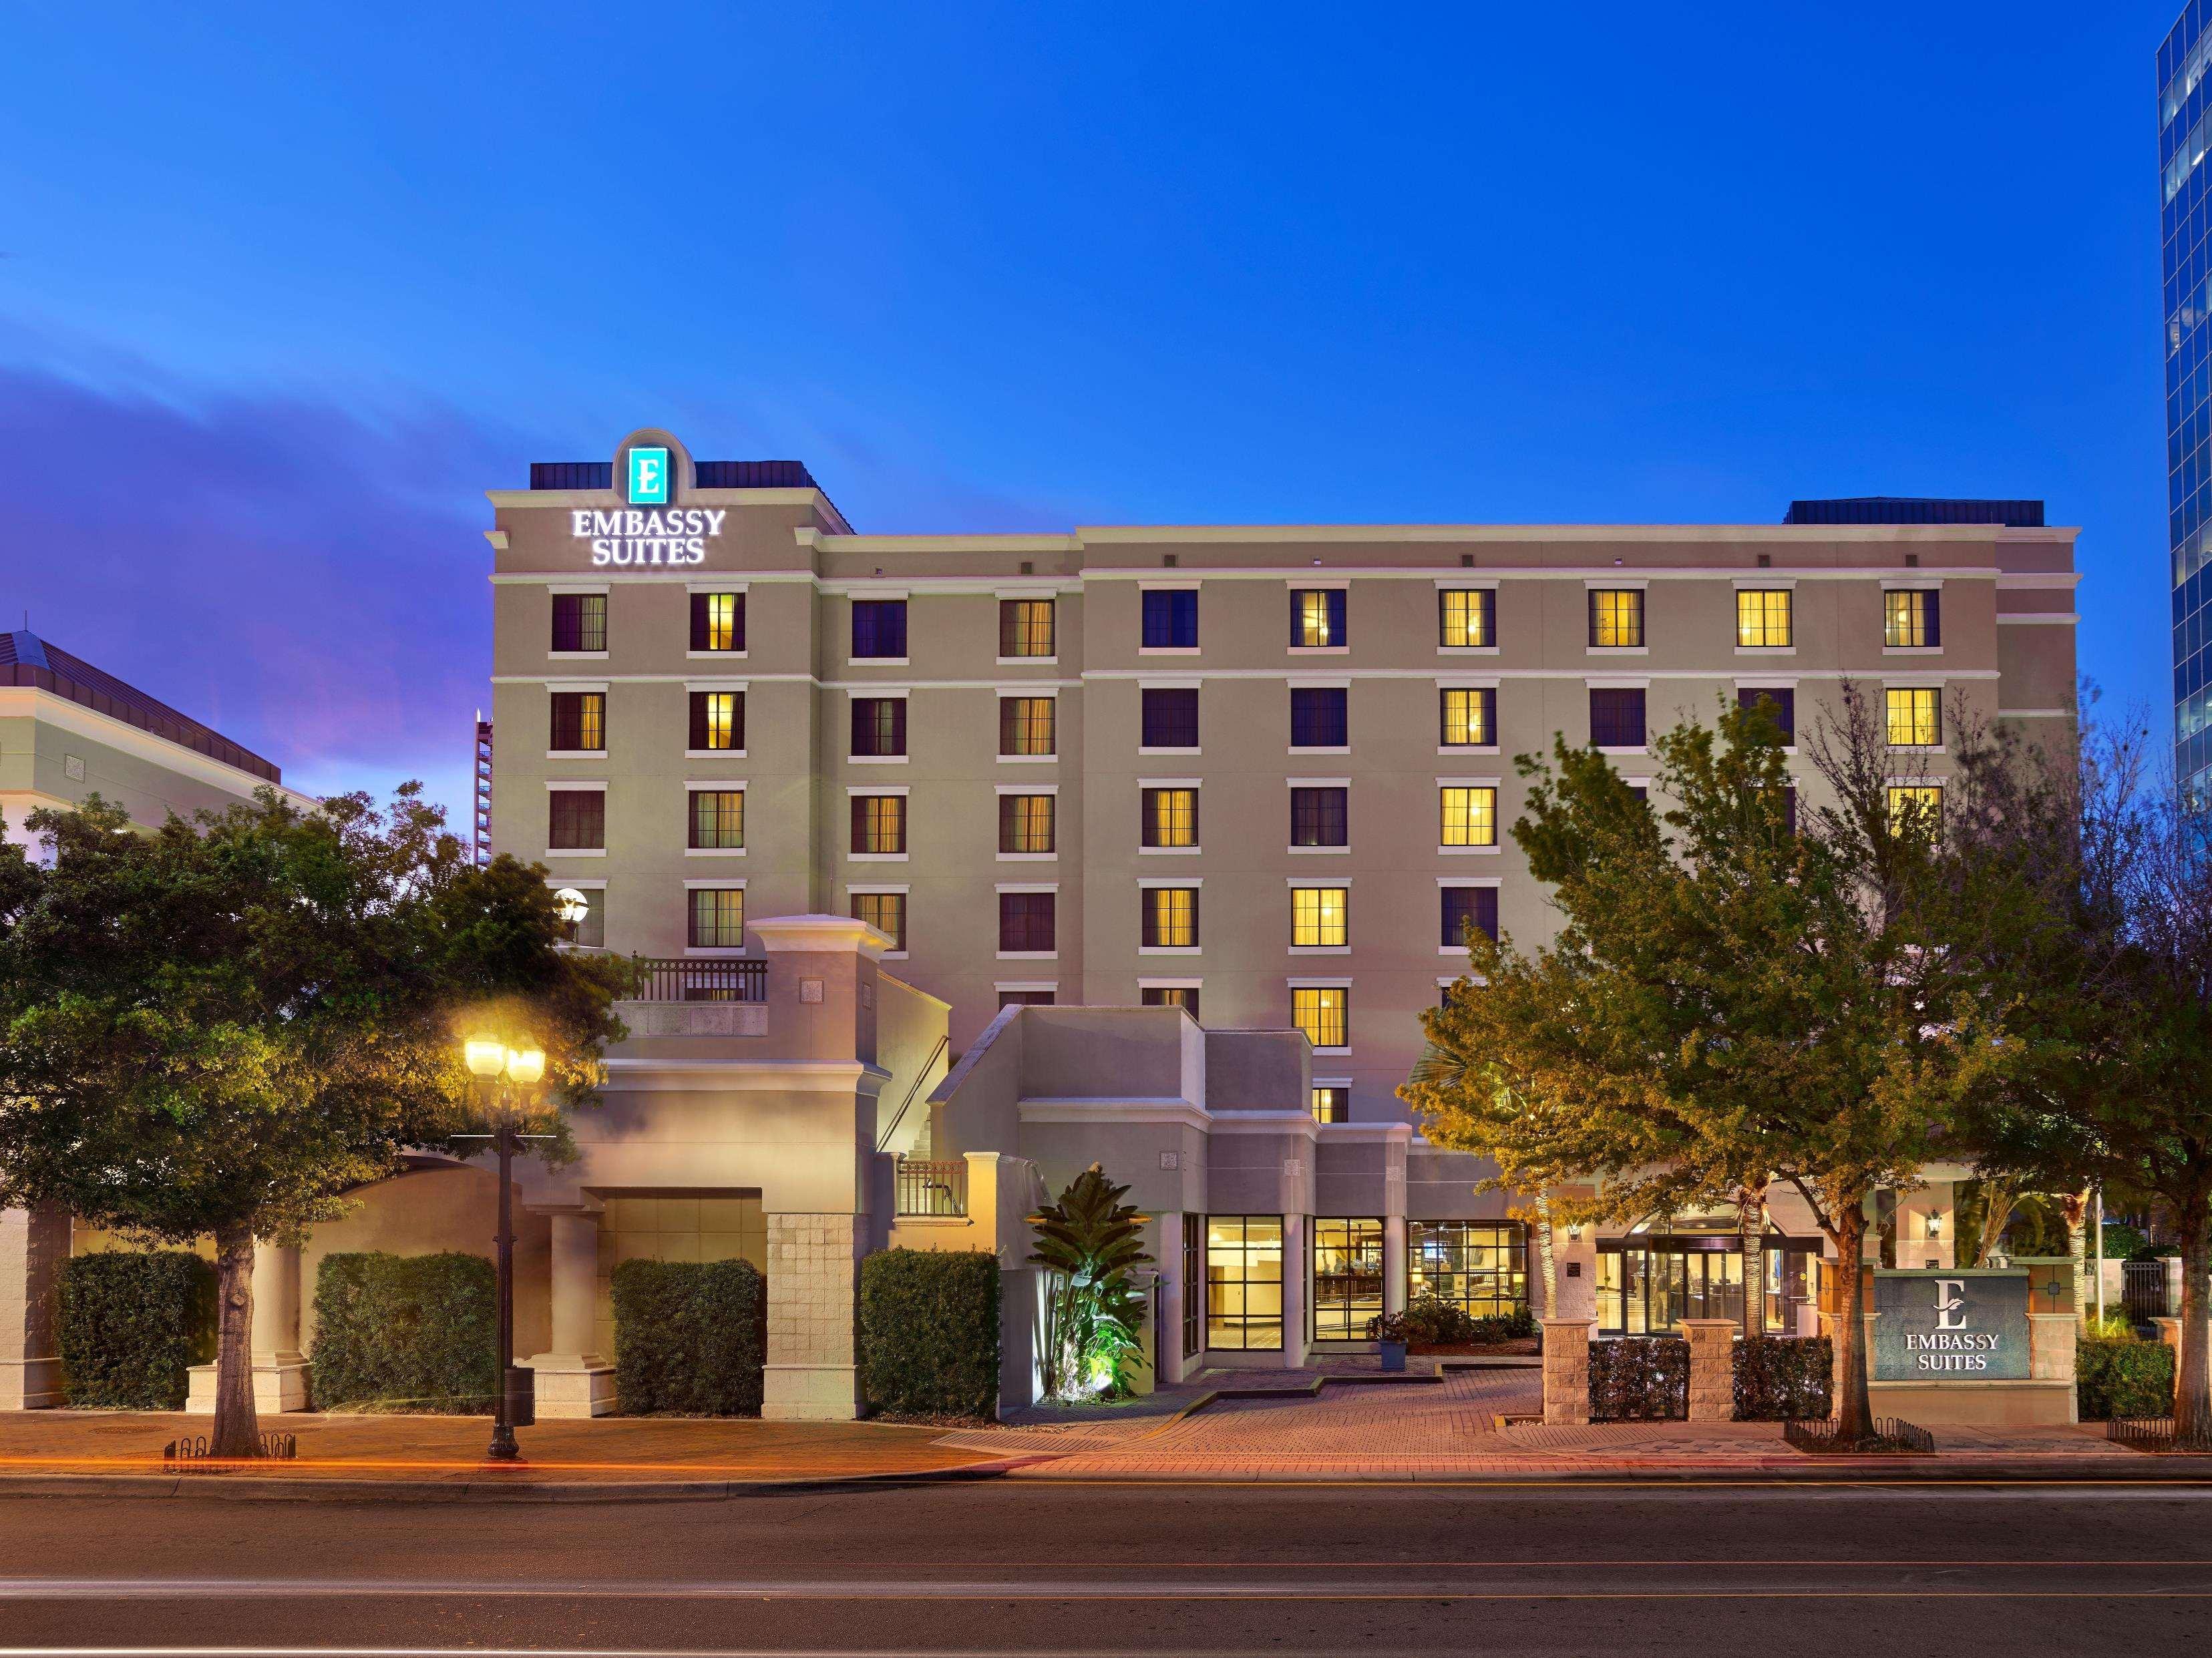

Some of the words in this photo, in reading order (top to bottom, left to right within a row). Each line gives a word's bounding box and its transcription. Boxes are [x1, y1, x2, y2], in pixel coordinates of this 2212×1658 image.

[572, 510, 726, 536] EMBASSY
[592, 538, 705, 565] SUITES
[1905, 1334, 1999, 1350] EMBASSY
[1918, 1354, 1987, 1370] SUITES
